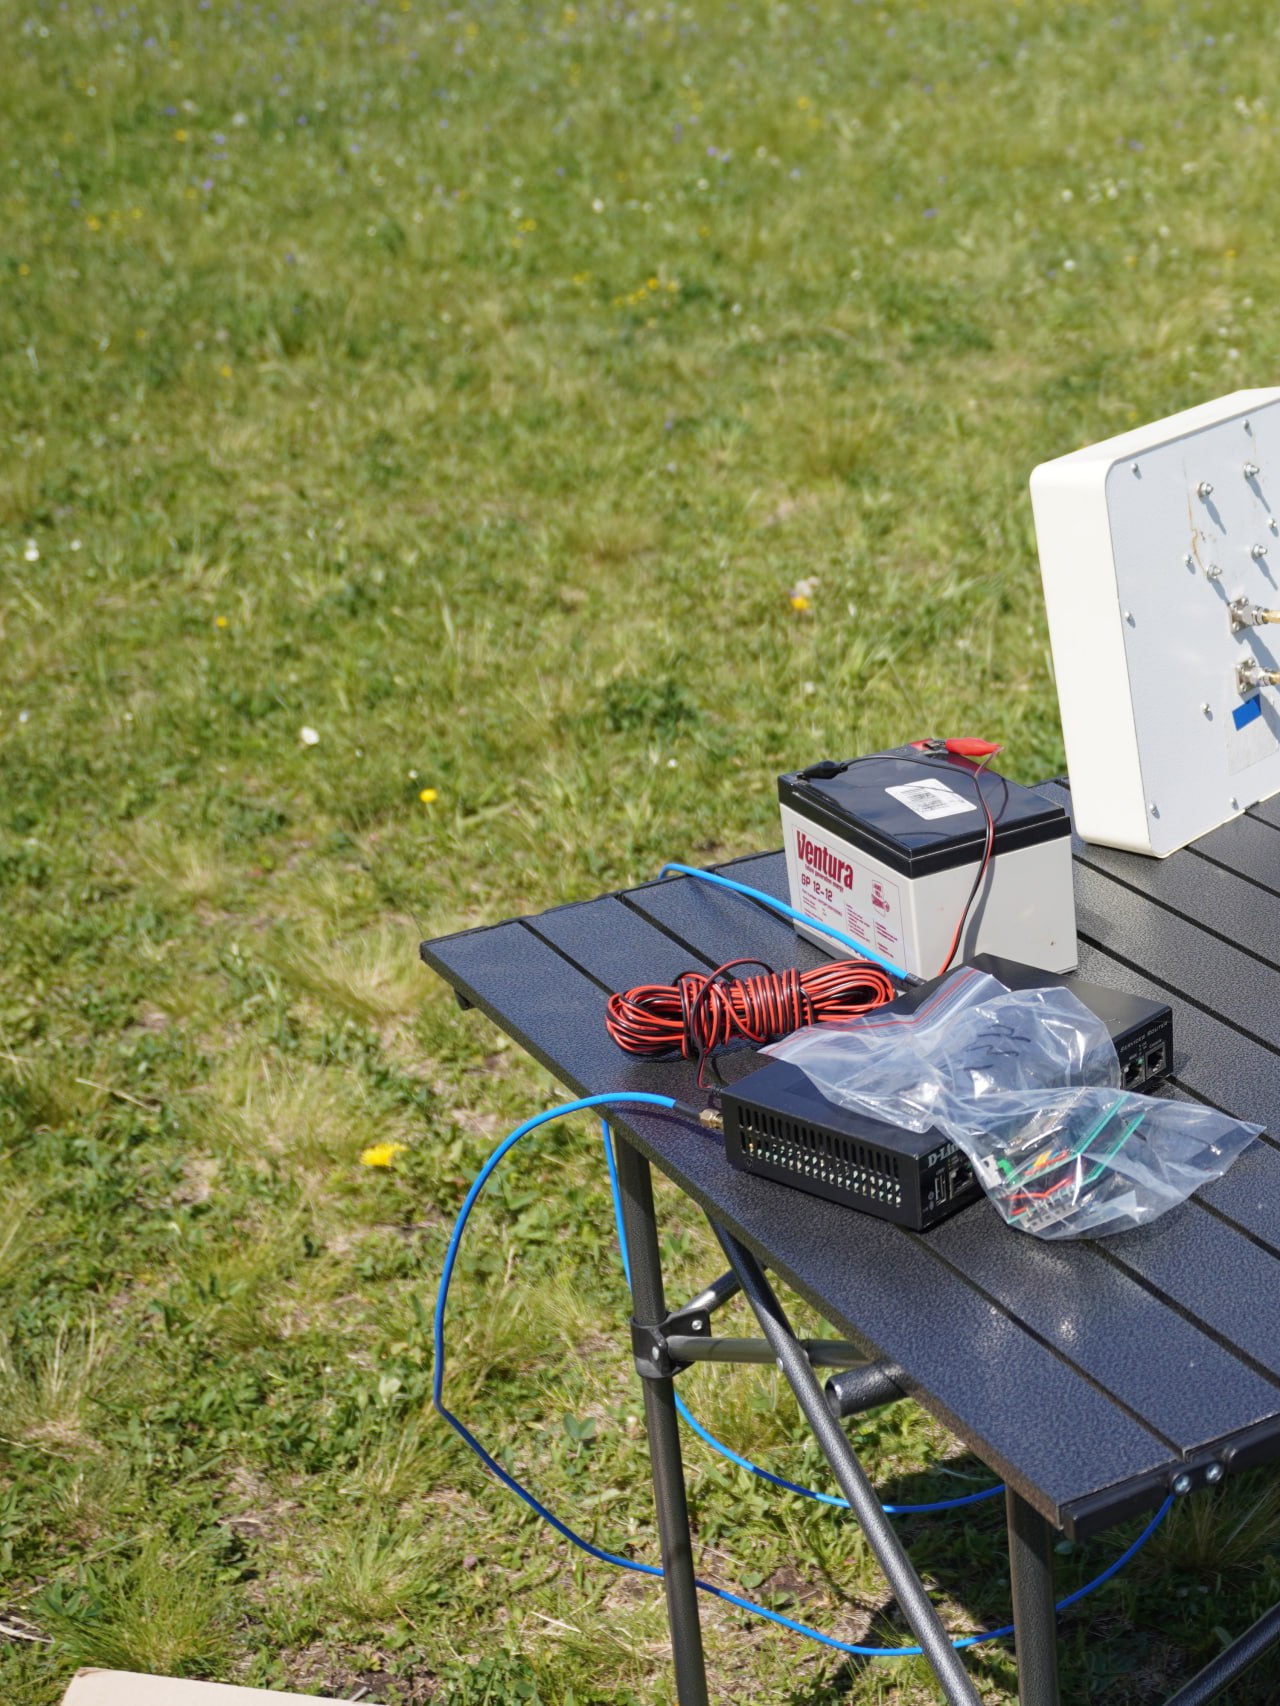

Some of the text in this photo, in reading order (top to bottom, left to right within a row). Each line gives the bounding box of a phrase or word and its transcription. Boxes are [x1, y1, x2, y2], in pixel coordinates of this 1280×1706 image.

[797, 830, 853, 890] Ventura
[813, 881, 833, 903] 12-12
[928, 1143, 958, 1168] D-Lin
